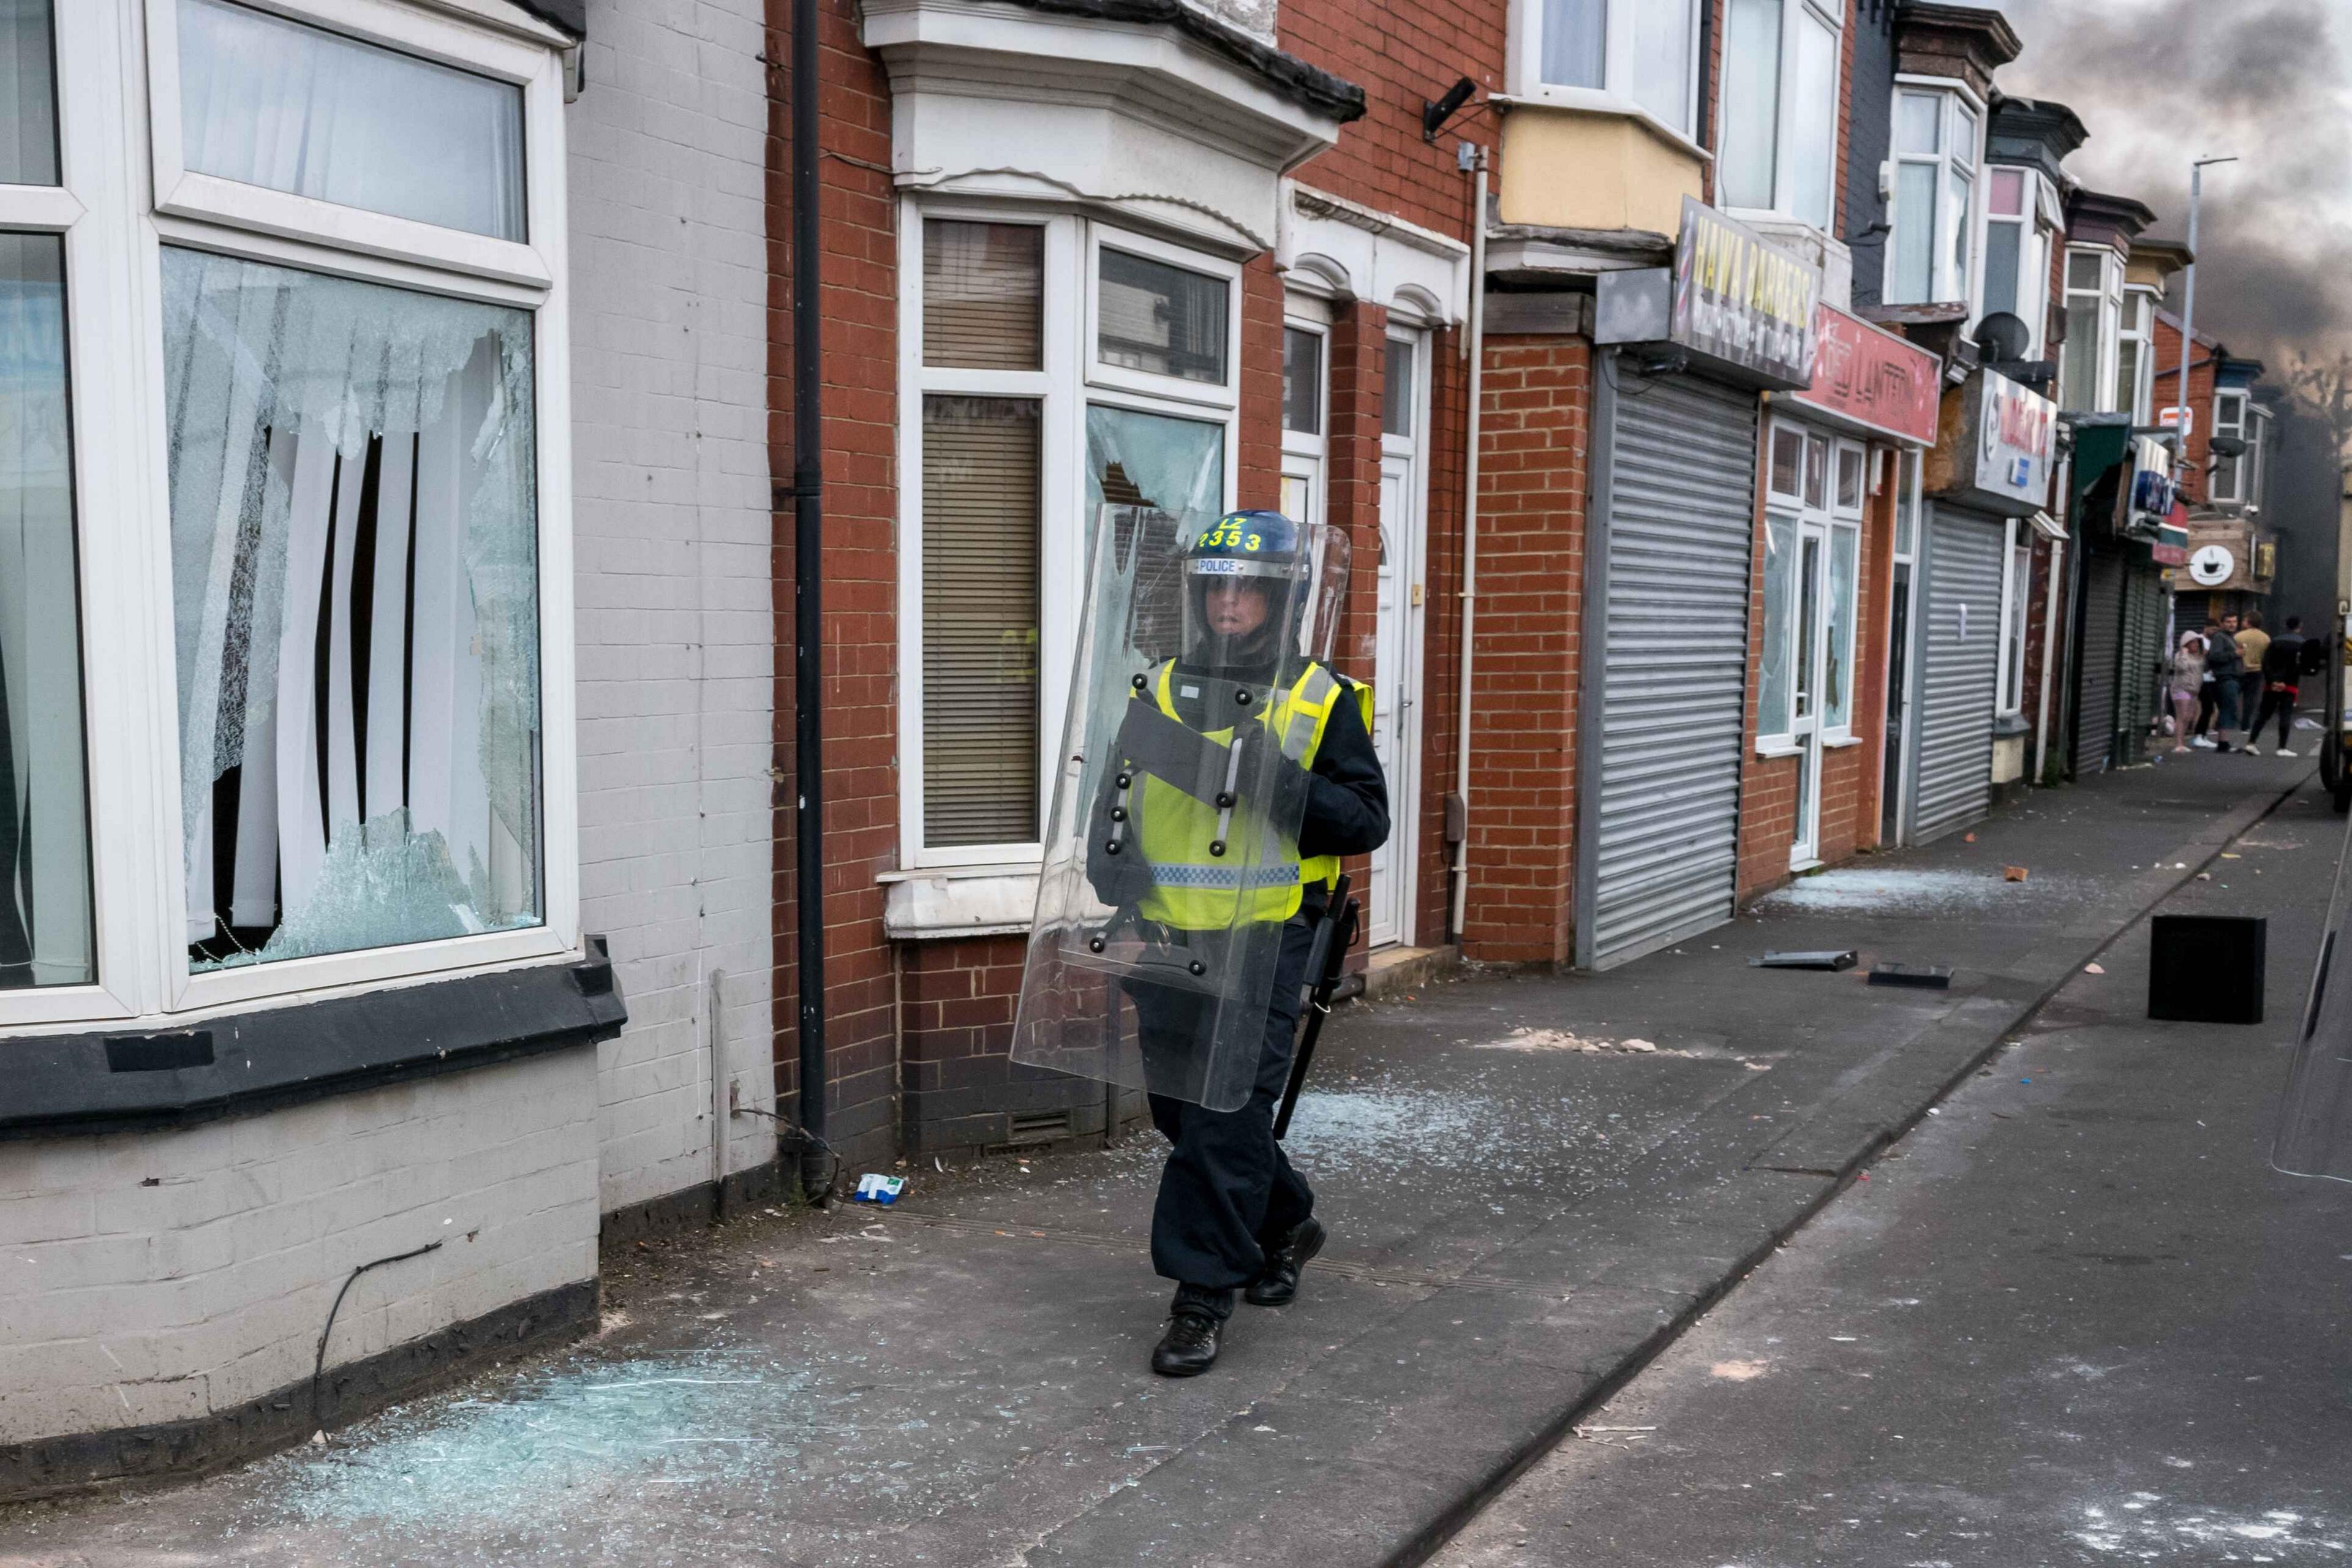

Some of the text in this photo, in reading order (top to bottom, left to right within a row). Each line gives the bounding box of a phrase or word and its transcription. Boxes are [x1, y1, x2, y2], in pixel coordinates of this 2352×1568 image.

[1693, 216, 1810, 329] HAWA BARBERS
[1218, 518, 1247, 530] LZ
[1199, 530, 1261, 551] 2353
[1200, 560, 1235, 572] POLICE
